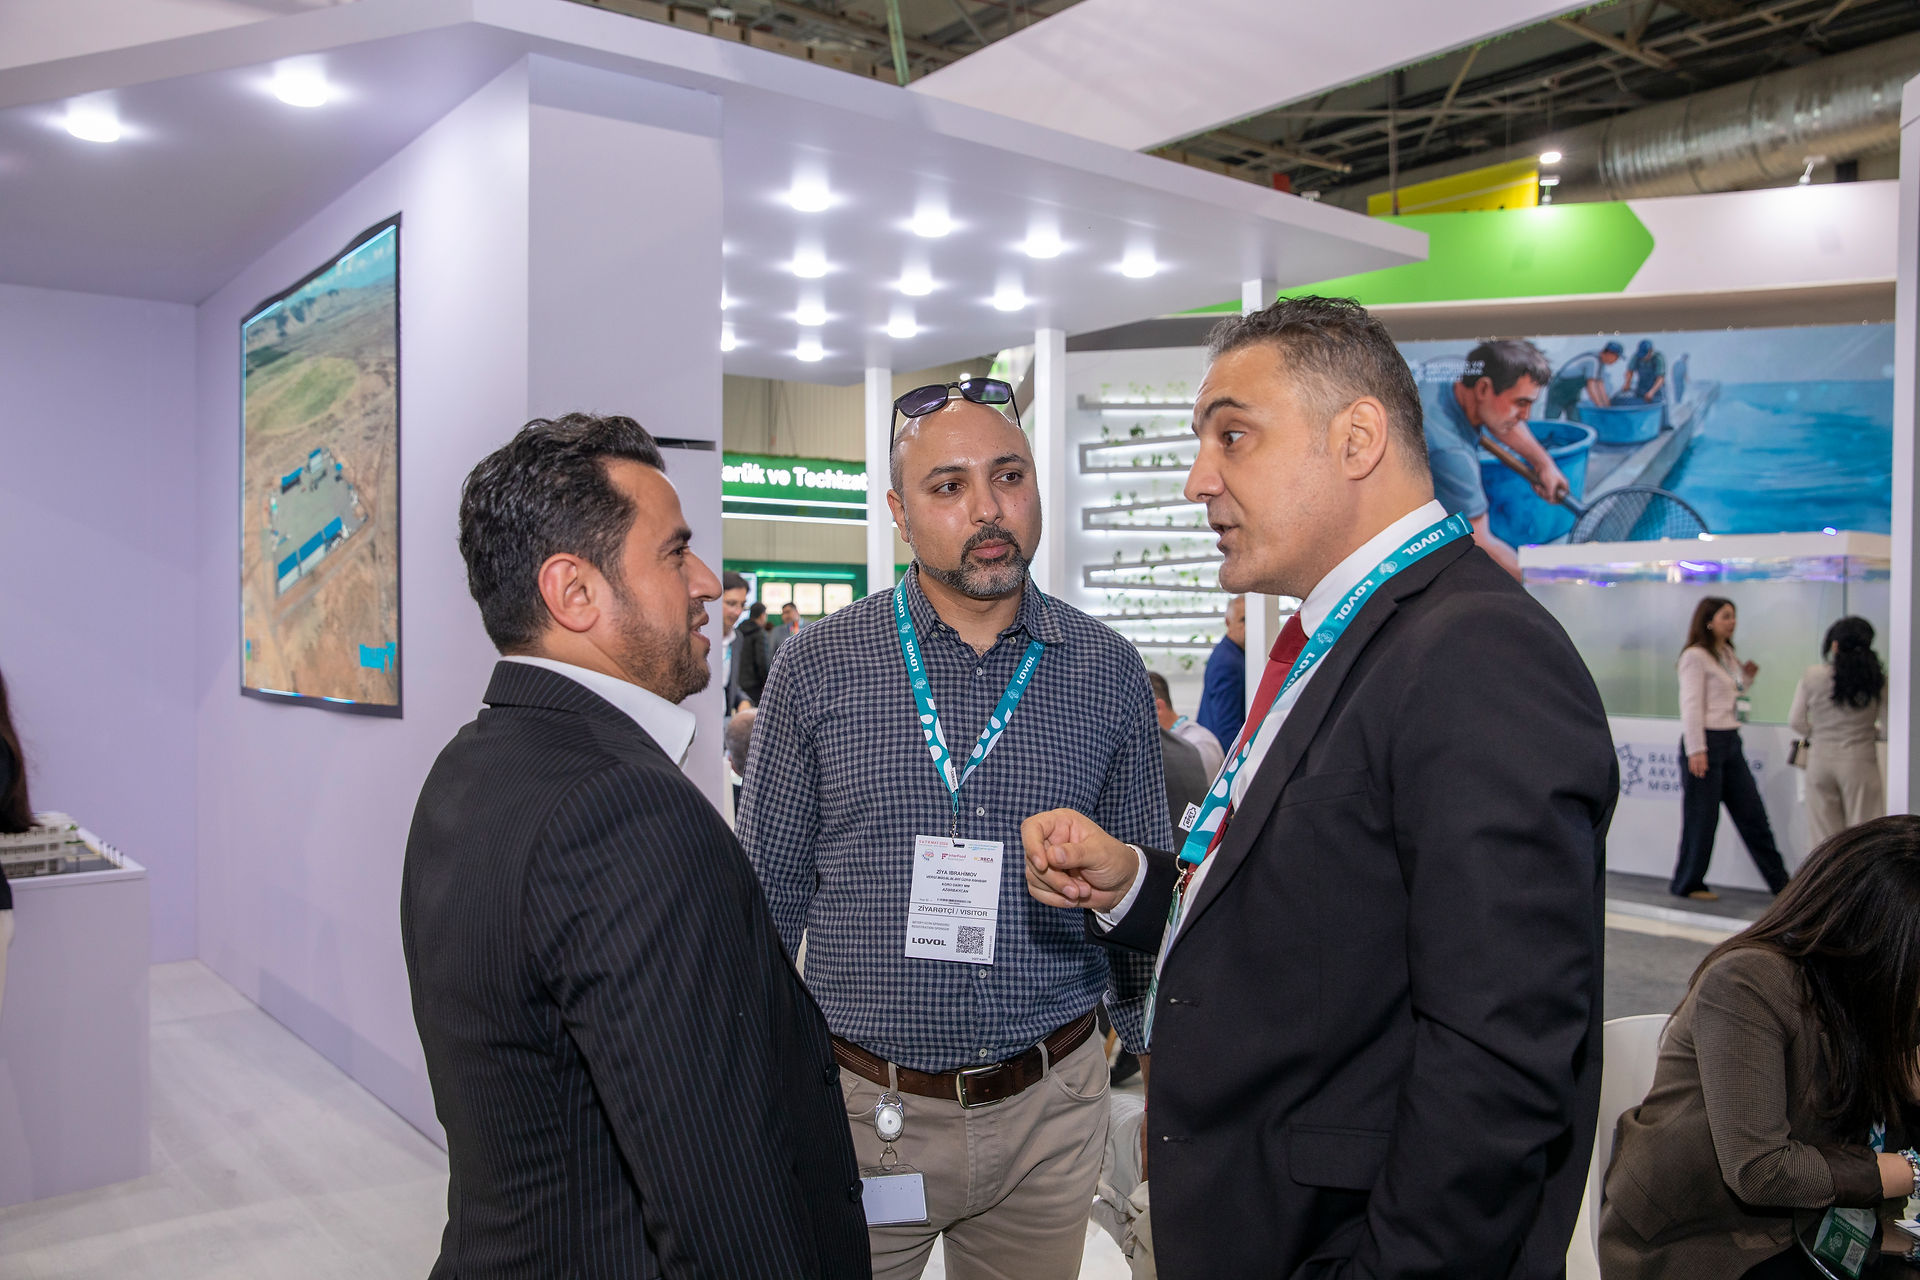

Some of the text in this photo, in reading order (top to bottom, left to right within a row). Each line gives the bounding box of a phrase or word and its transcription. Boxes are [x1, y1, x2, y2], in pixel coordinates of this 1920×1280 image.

[1402, 528, 1445, 556] LOVOL
[896, 590, 905, 618] LOVOL
[1334, 579, 1374, 622] LOVOL
[905, 639, 920, 673] LOVOL
[1016, 655, 1036, 685] LOVOL
[1648, 767, 1676, 777] AKV
[918, 905, 955, 915] ZİYARƏTÇİ
[960, 908, 988, 917] VISITOR
[911, 937, 947, 946] LOVOL
